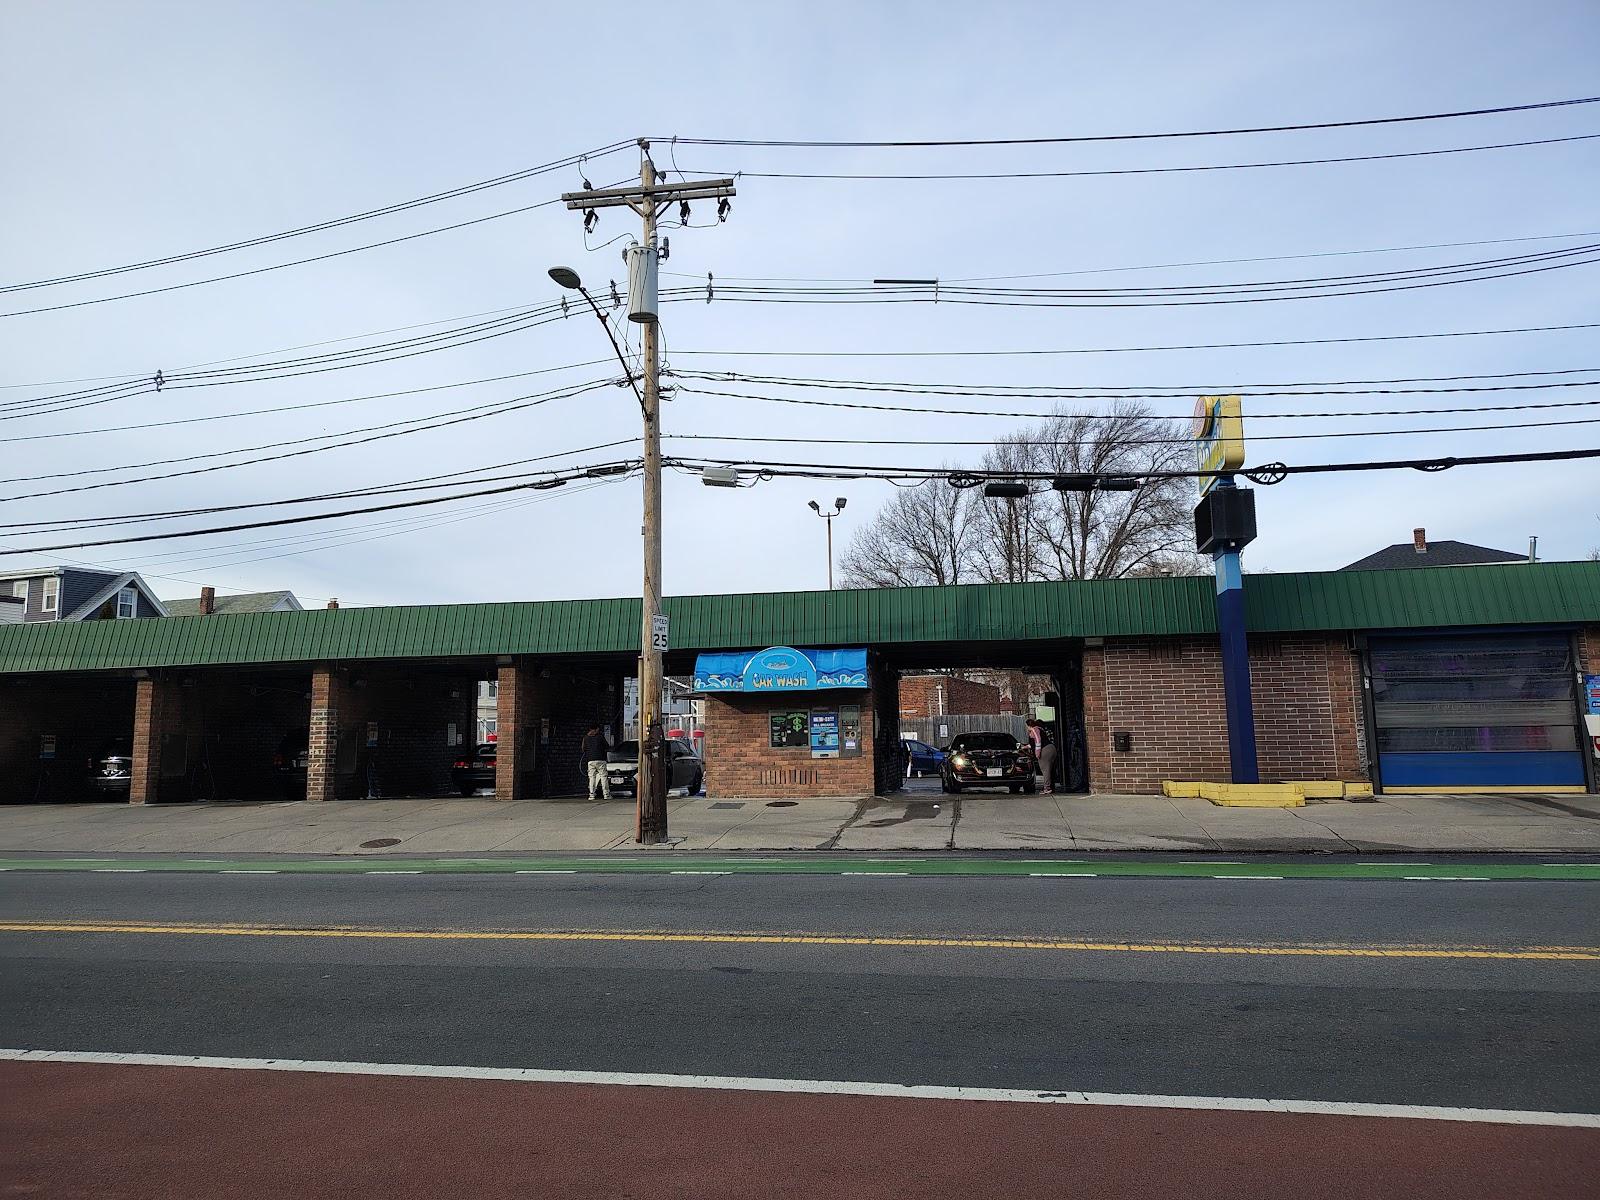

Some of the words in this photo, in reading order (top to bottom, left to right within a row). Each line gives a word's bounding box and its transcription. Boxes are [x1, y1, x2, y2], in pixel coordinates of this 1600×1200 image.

[654, 634, 668, 647] 25
[752, 672, 773, 688] CAR
[775, 671, 808, 687] WASH
